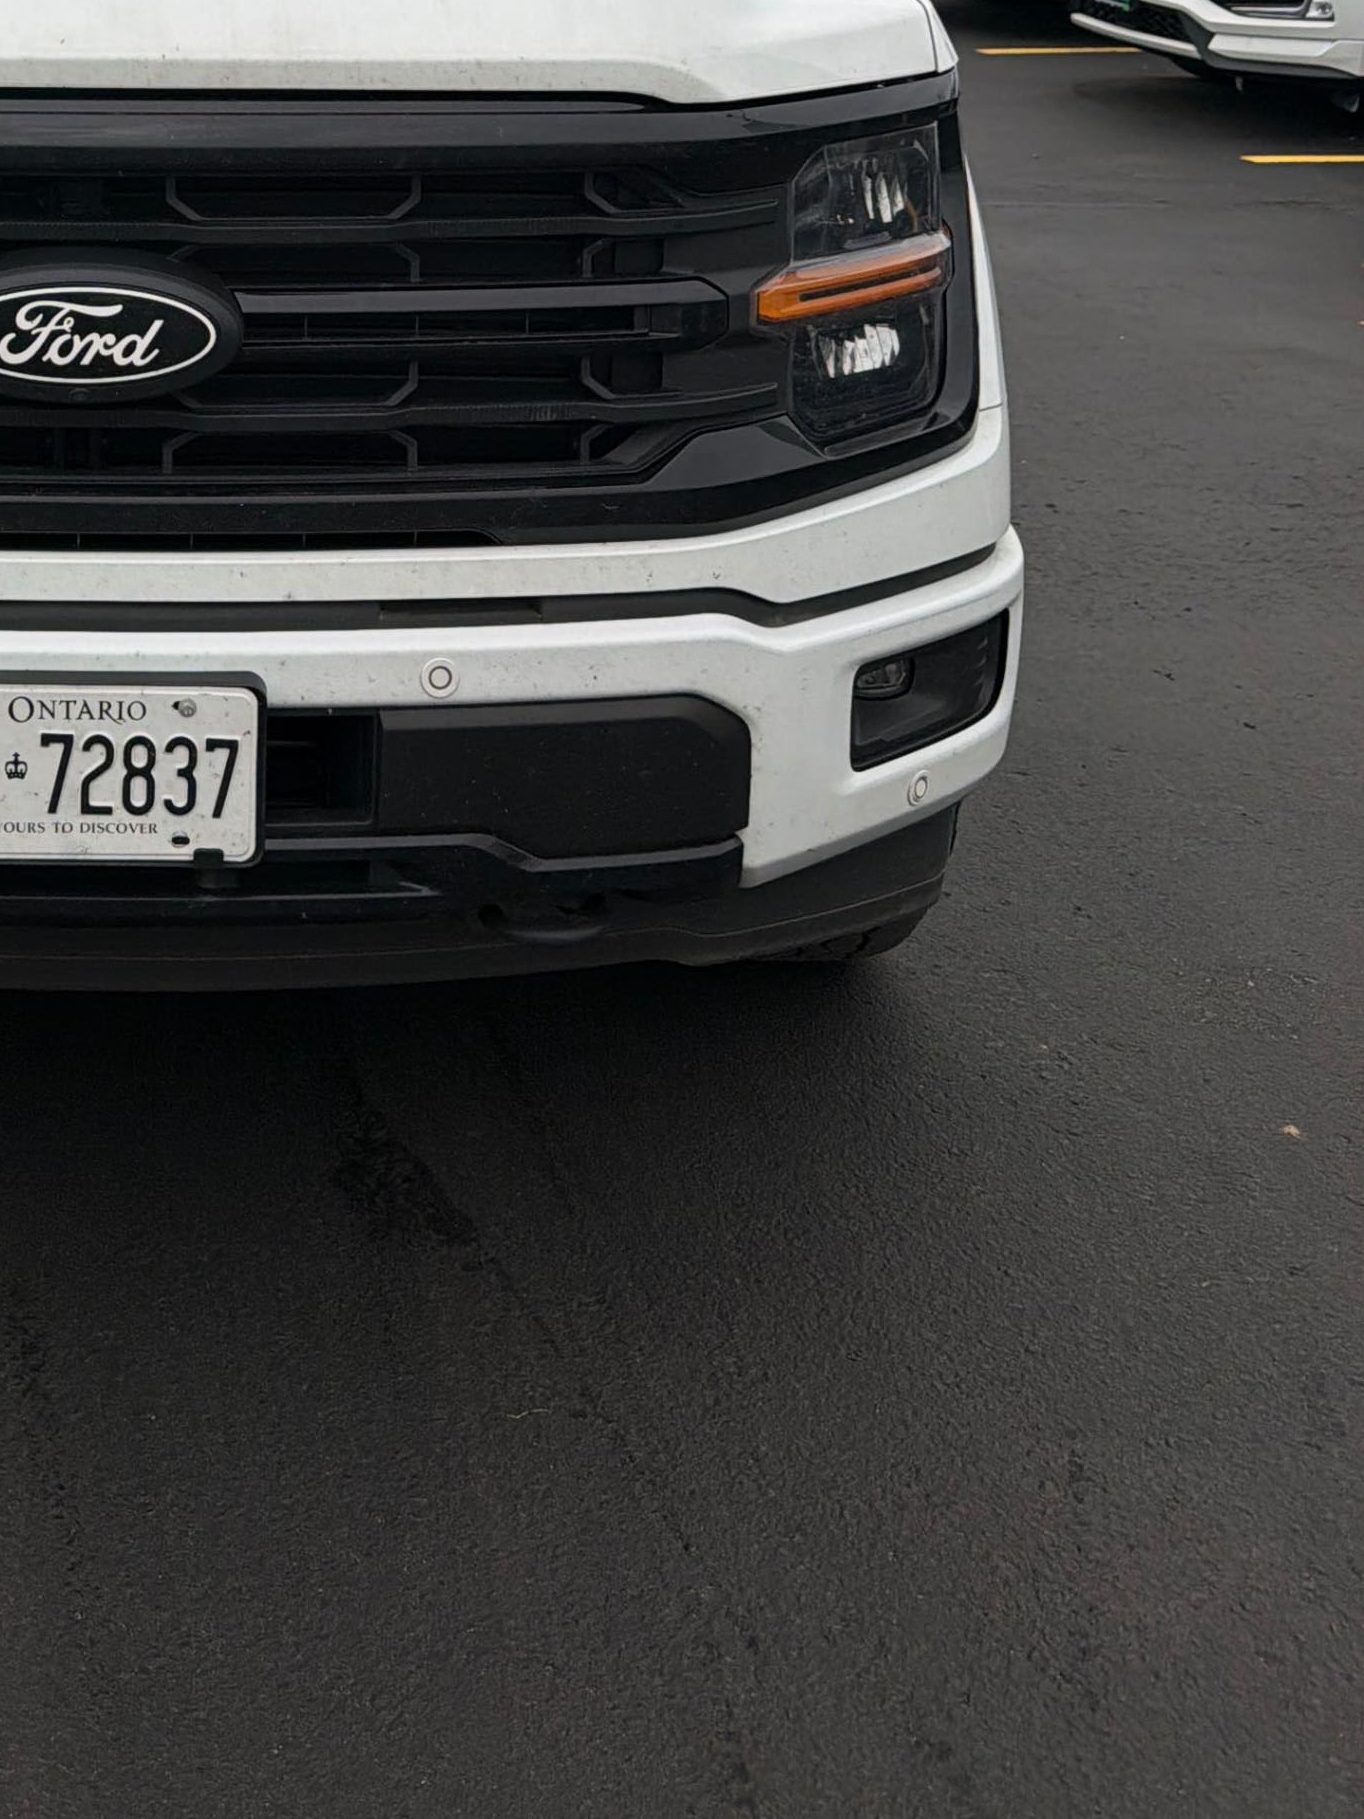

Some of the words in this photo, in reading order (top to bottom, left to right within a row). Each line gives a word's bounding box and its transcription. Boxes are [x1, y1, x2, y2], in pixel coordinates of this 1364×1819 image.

[8, 695, 147, 725] ONTARIO
[39, 732, 240, 819] 72837
[51, 821, 74, 834] TO
[79, 821, 158, 835] DISCOVER
